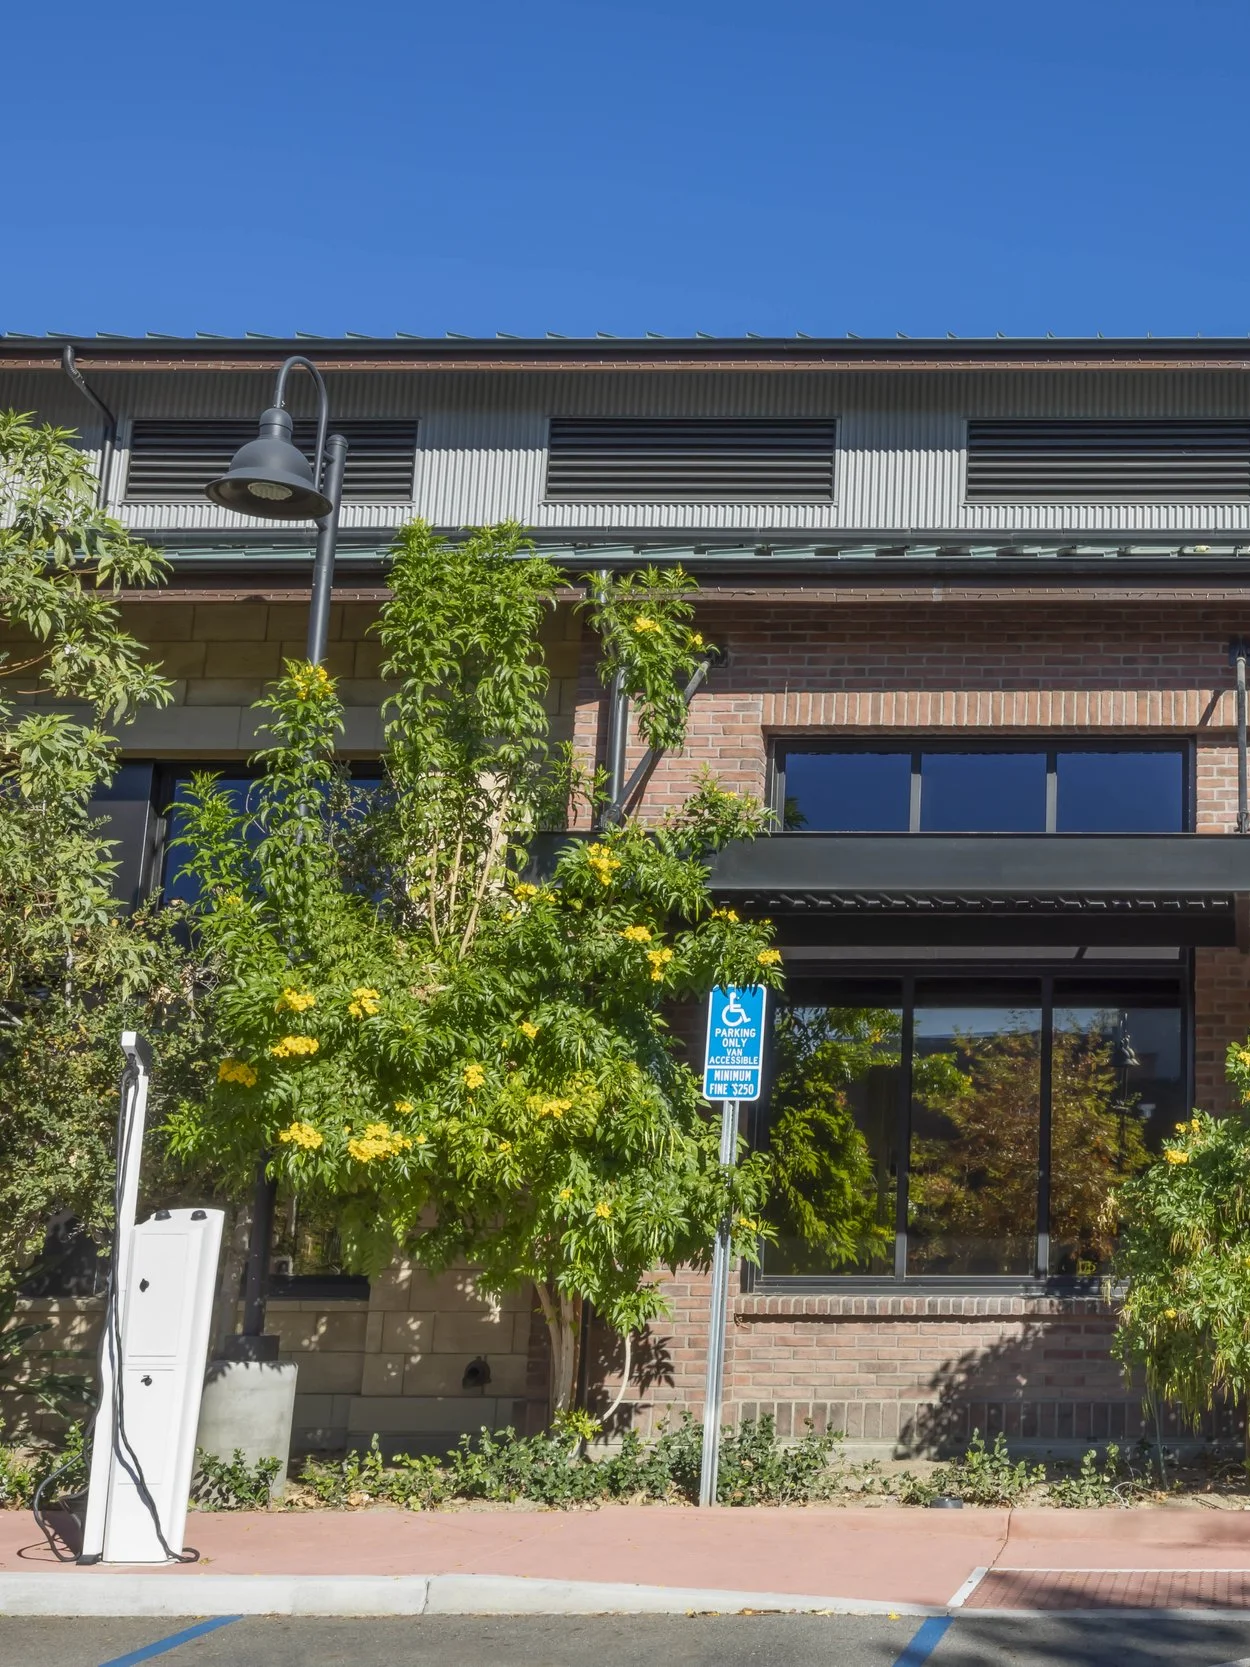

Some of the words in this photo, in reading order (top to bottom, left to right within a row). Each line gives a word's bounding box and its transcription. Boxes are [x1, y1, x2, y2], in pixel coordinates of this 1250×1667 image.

[715, 1028, 756, 1038] PARKING
[722, 1038, 747, 1047] ONLY
[726, 1048, 742, 1056] VAN
[709, 1056, 758, 1064] ACCESSIBLE
[714, 1070, 752, 1081] MINIMUM
[710, 1084, 728, 1095] FINE
[731, 1083, 754, 1096] $250
